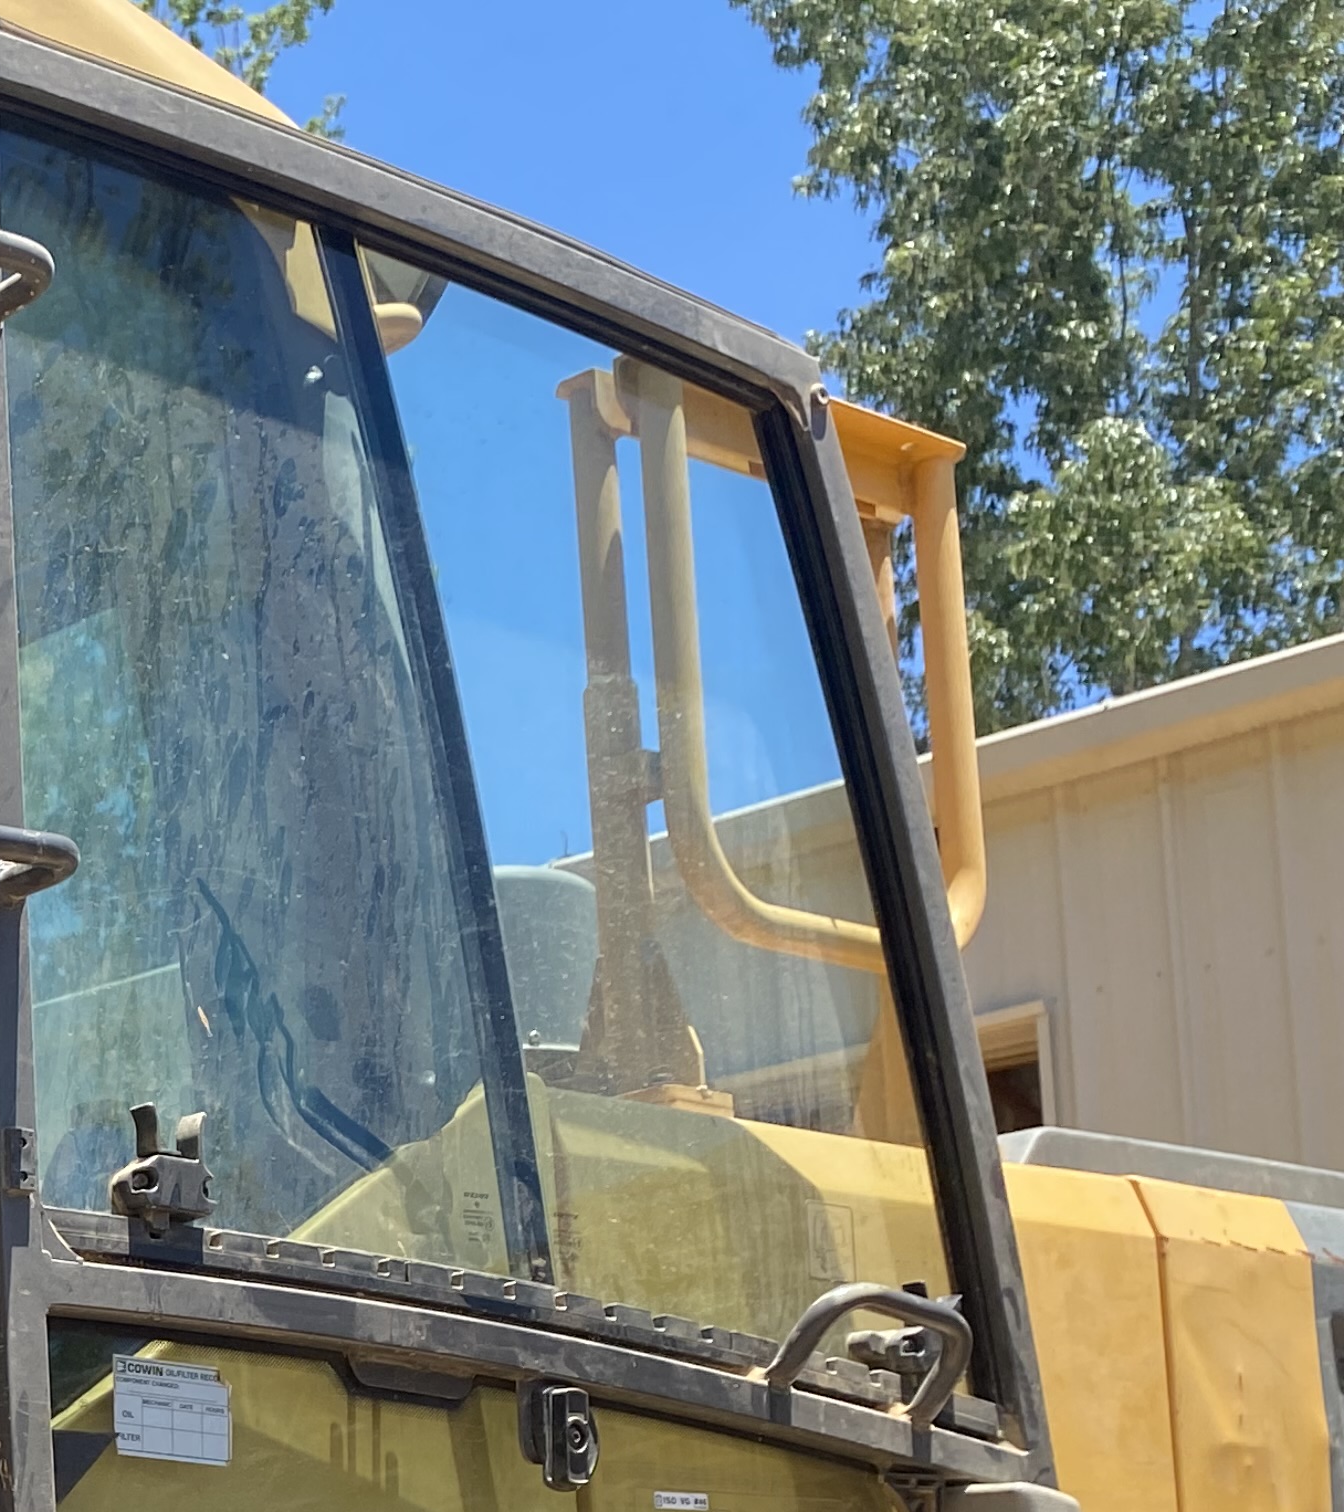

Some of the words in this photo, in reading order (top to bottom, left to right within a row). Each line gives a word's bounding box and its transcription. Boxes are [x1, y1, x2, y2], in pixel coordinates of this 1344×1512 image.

[127, 1363, 163, 1376] COWIN
[166, 1369, 198, 1379] OIL/FILTER
[116, 1376, 150, 1385] COMPONENT
[142, 1399, 171, 1407] MECHANIC
[122, 1410, 134, 1418] OIL
